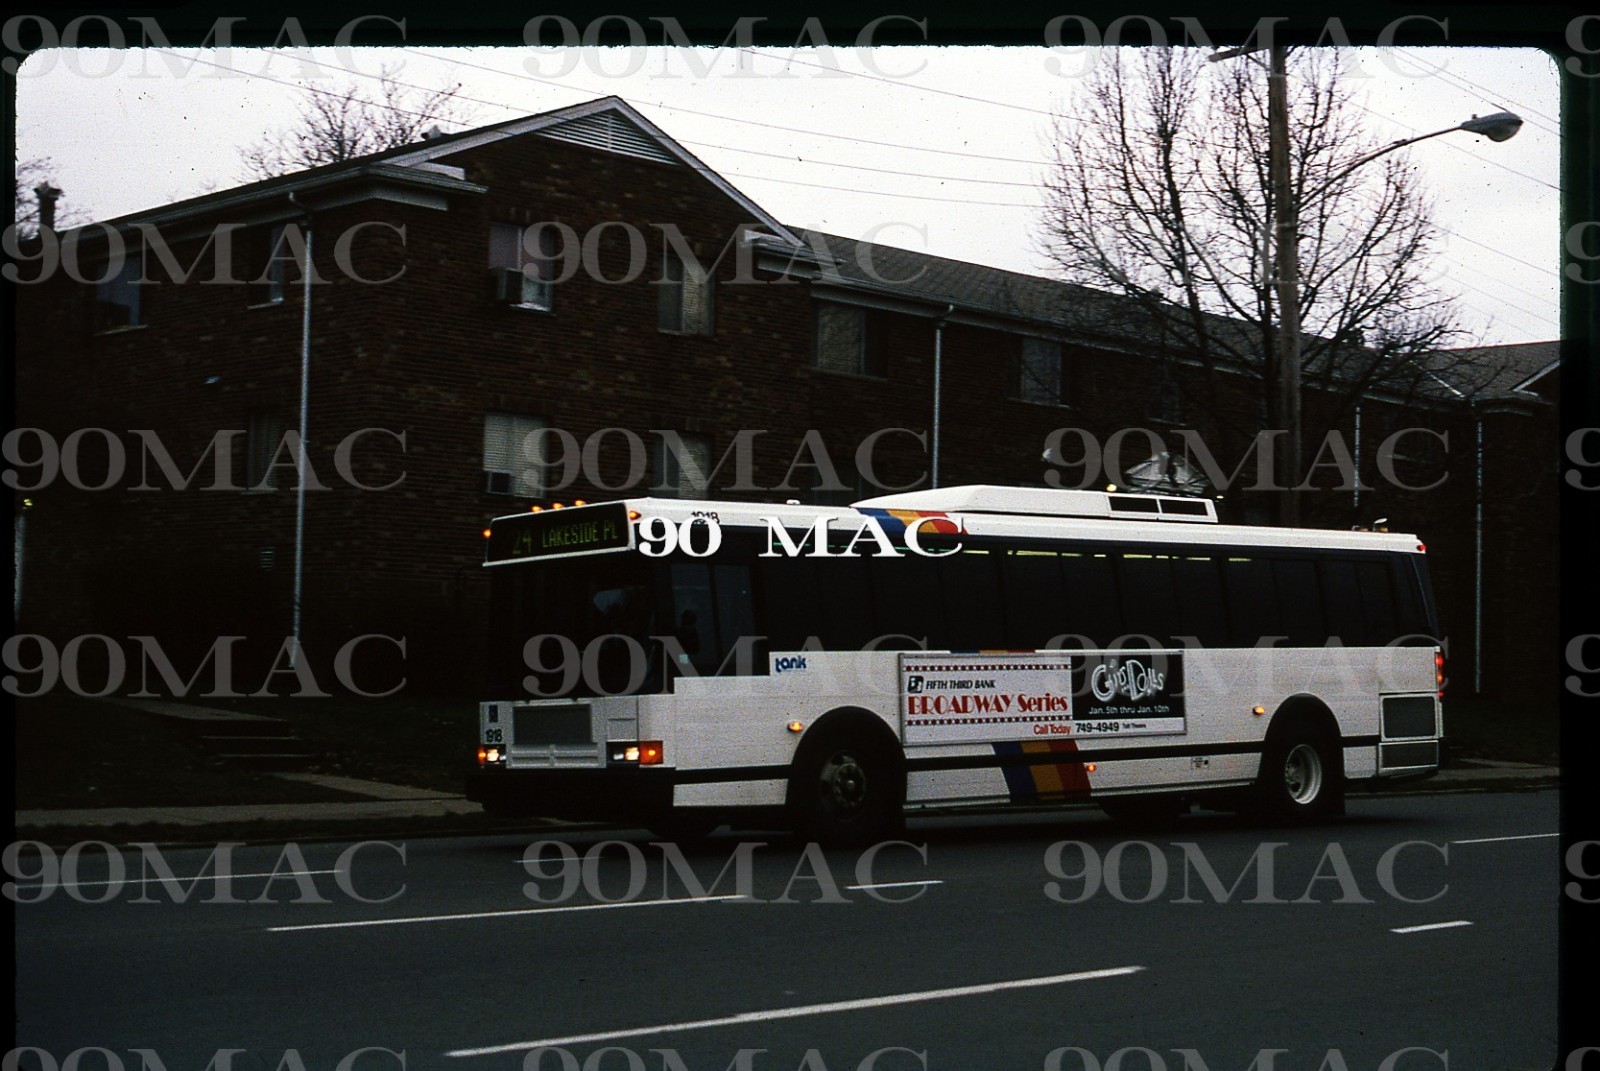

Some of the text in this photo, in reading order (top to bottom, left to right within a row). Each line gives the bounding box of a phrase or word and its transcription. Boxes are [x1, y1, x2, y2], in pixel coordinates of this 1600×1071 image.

[541, 521, 600, 548] LAKESIDE
[603, 519, 619, 541] PL
[775, 655, 807, 673] tank
[925, 679, 948, 690] FIFTH
[949, 679, 973, 690] THIRD
[974, 679, 996, 689] BANK
[908, 692, 1069, 715] BROADWAY Series
[1120, 705, 1136, 714] thru
[1033, 724, 1049, 735] Call
[1049, 723, 1072, 736] Today
[1075, 721, 1120, 733] 749-4949
